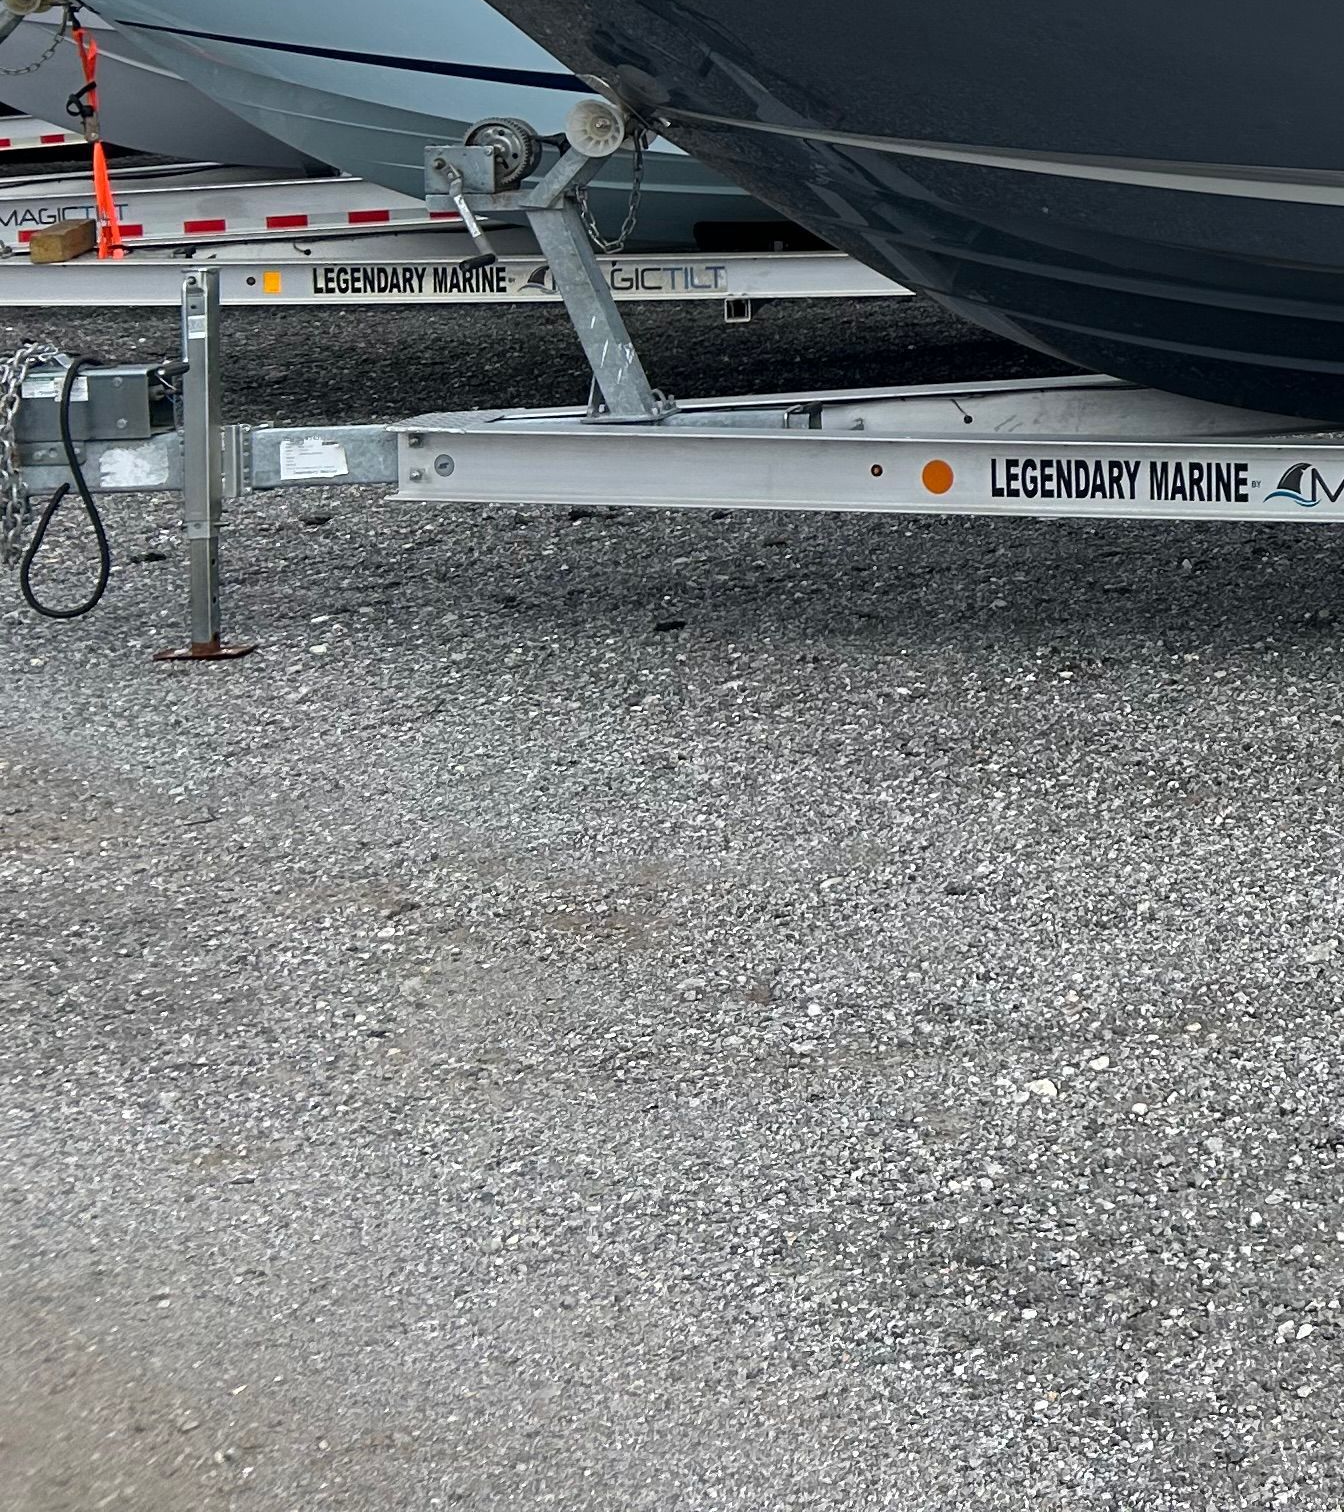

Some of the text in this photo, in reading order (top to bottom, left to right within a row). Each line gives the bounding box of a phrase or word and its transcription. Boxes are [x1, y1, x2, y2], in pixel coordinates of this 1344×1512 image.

[312, 265, 725, 294] LEGENDARY MARINE GICTILT
[991, 458, 1141, 500] LEGENDARY
[1149, 461, 1249, 502] MARINE
[1251, 480, 1262, 489] BY
